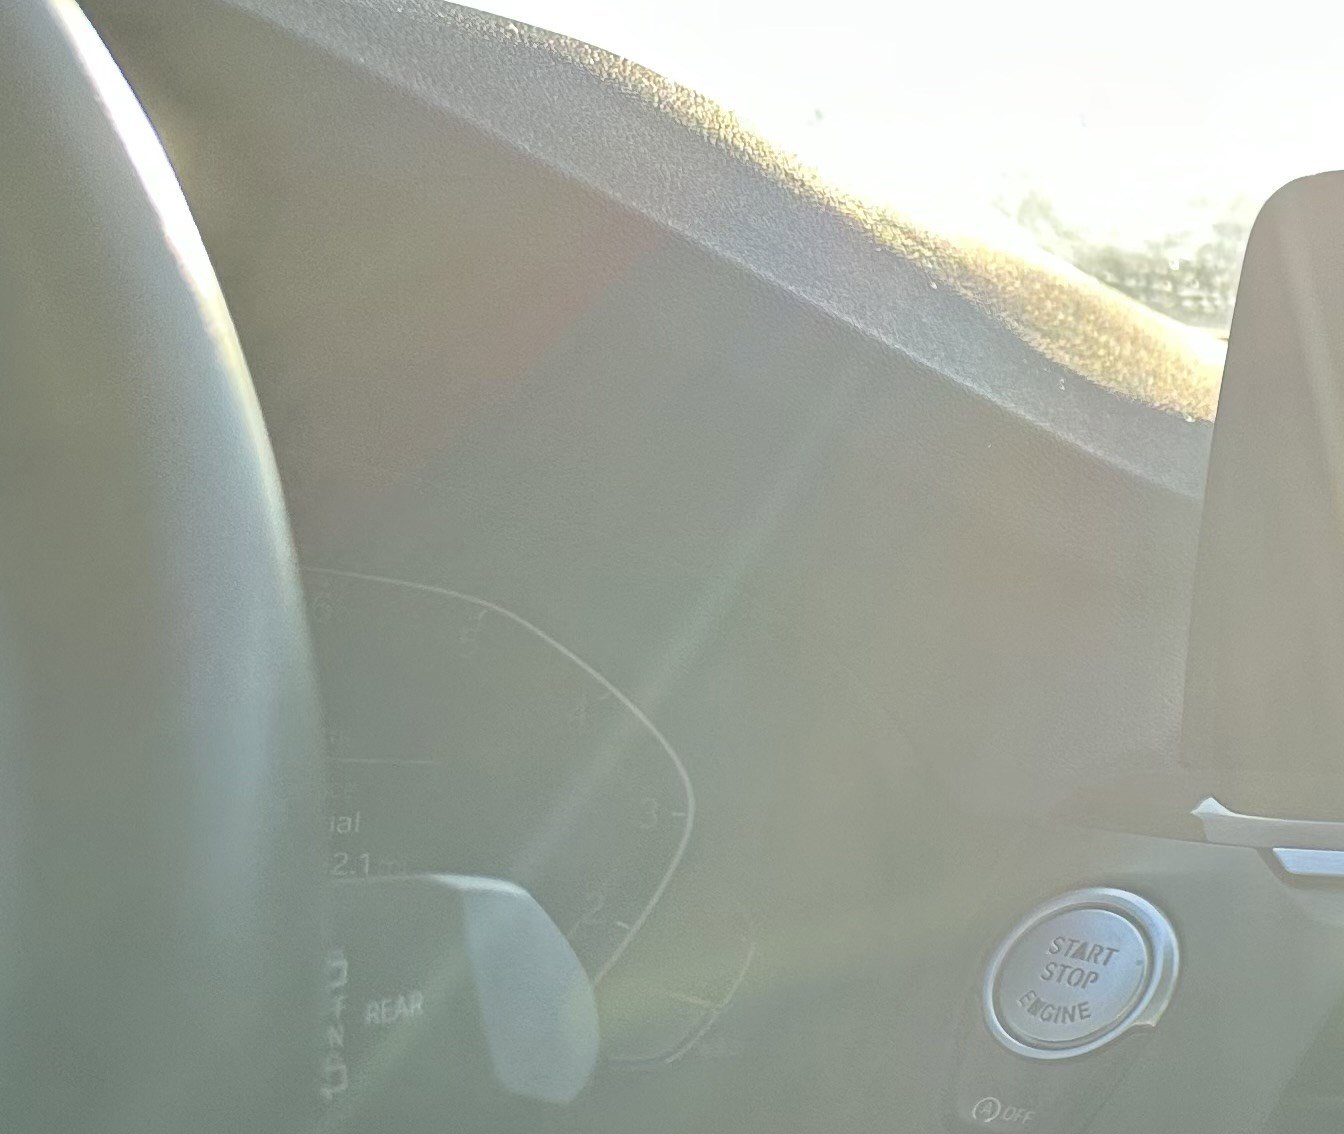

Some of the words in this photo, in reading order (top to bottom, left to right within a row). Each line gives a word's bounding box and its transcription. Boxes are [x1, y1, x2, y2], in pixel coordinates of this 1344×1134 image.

[1048, 935, 1120, 967] START
[1039, 961, 1100, 990] STOP
[364, 990, 424, 1026] REAR
[1017, 989, 1093, 1024] ENGINE
[1003, 1106, 1036, 1124] OFF
